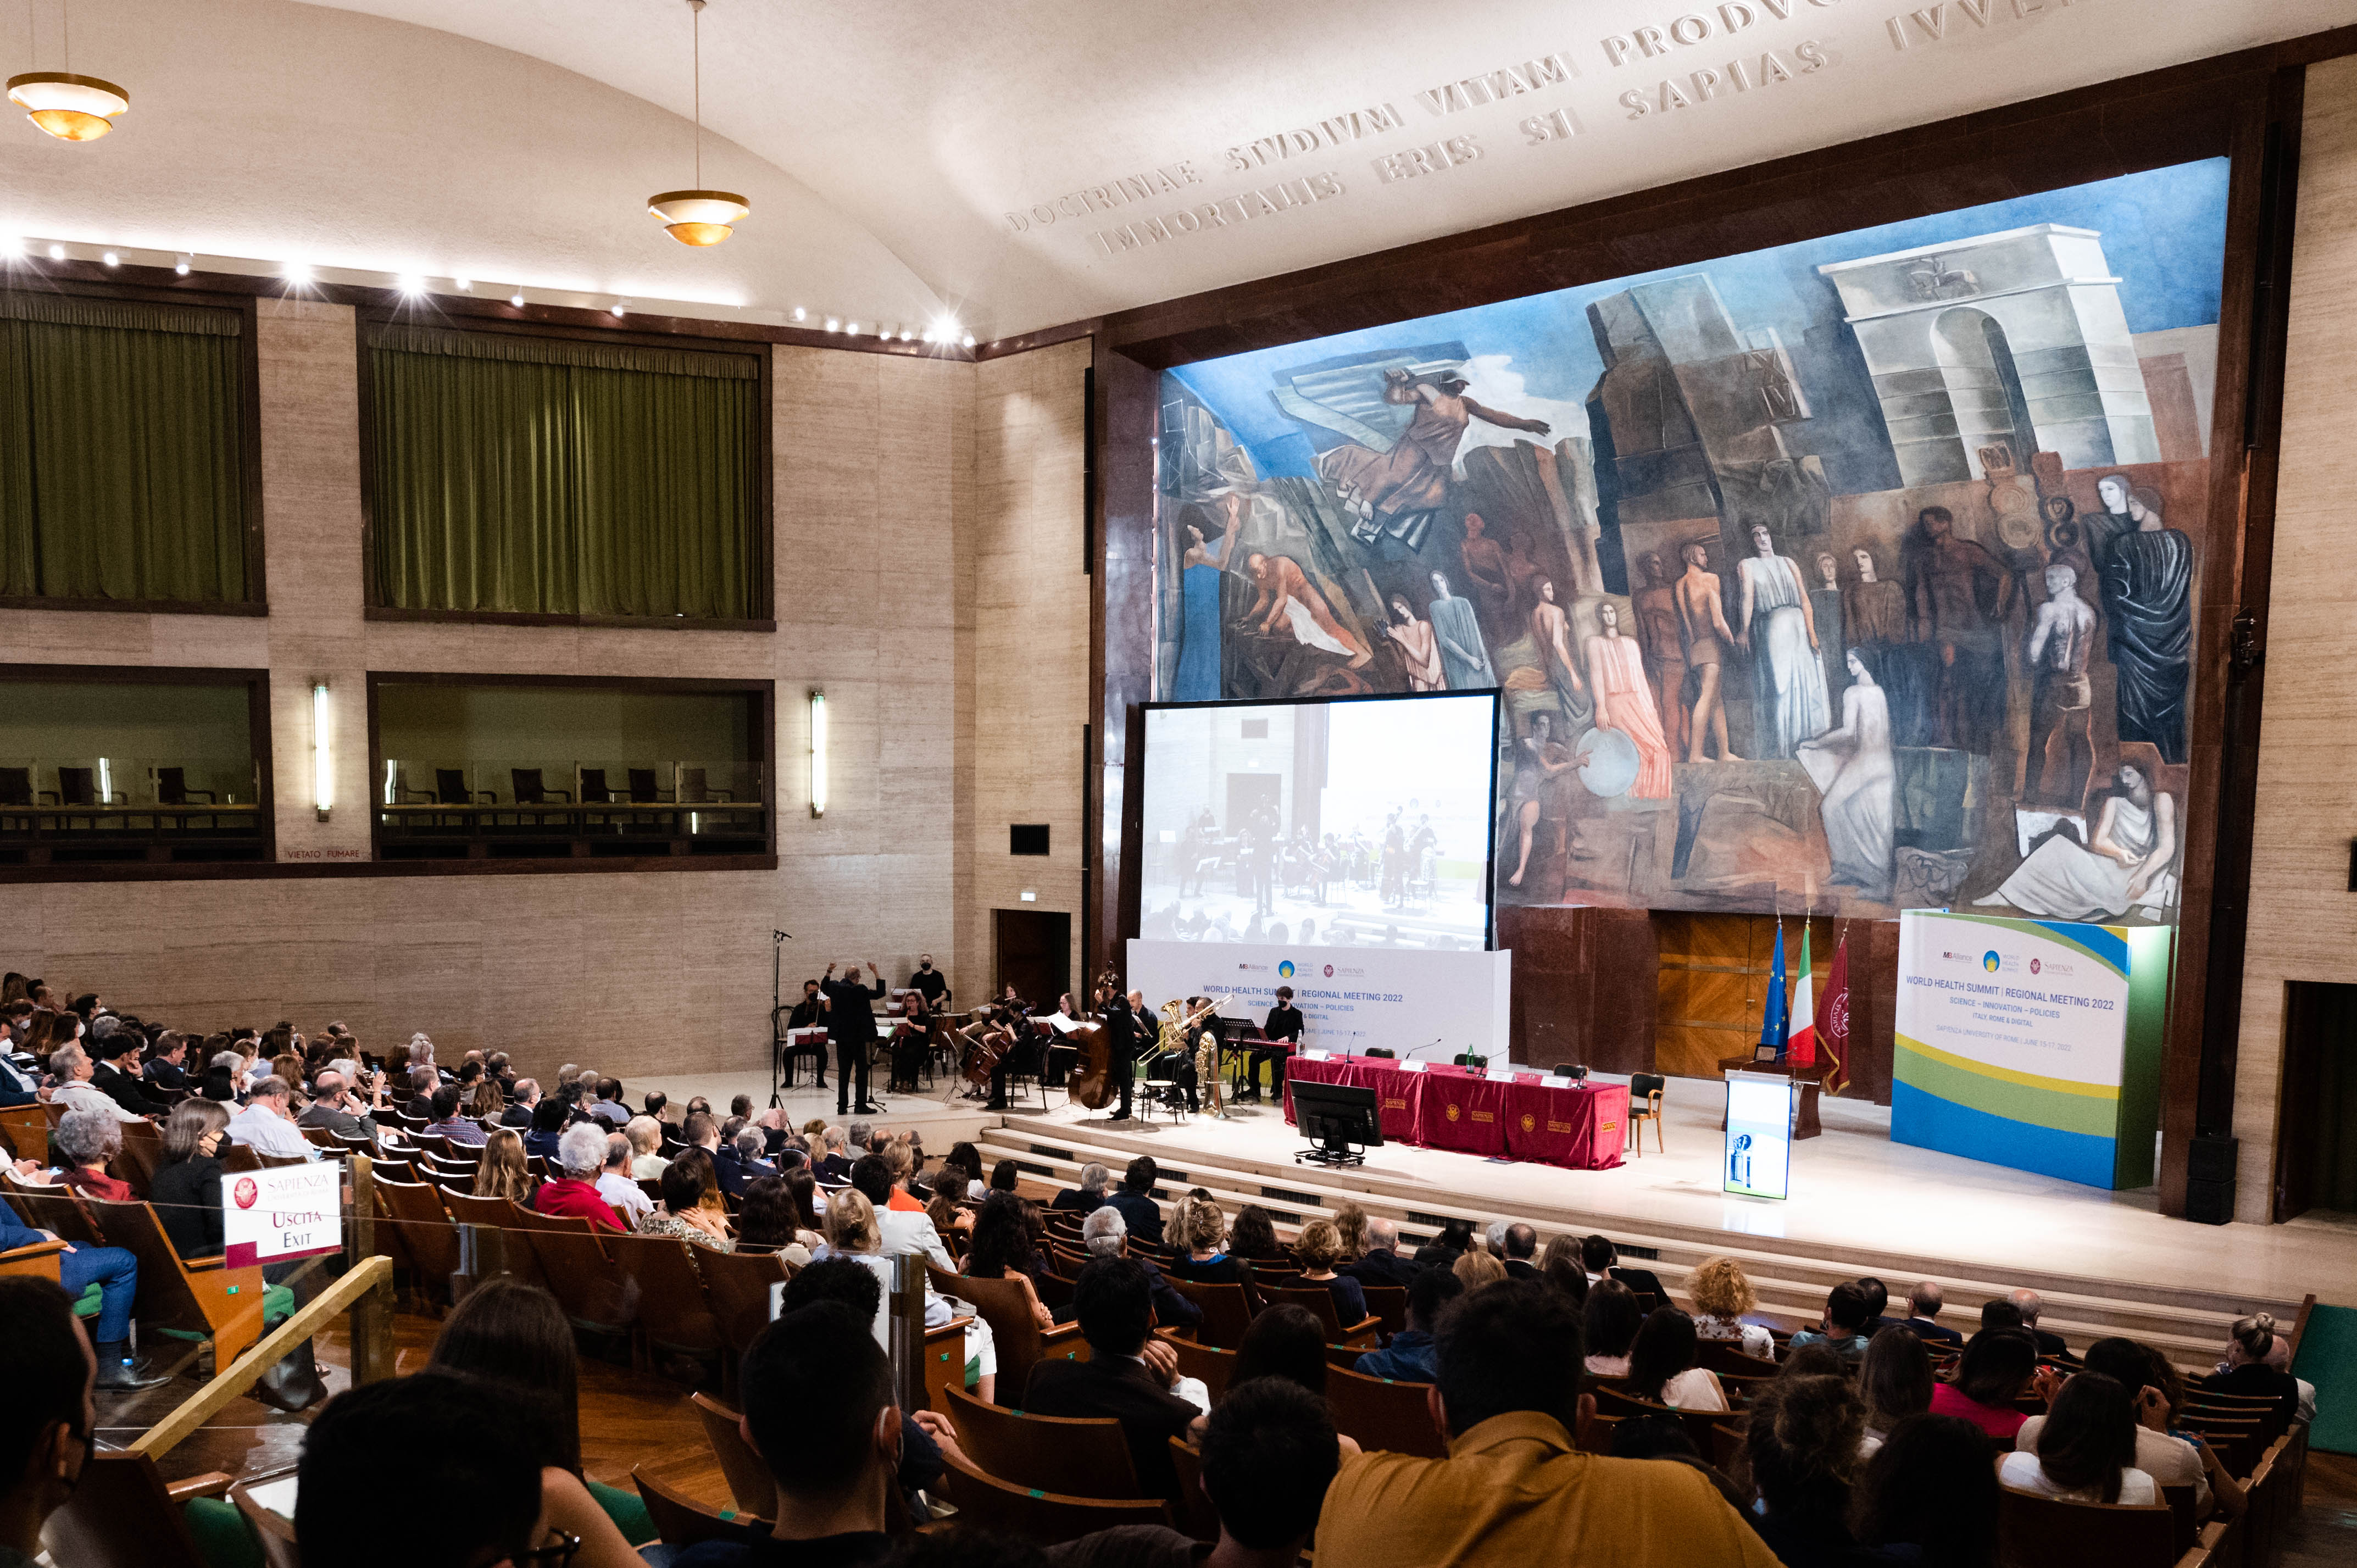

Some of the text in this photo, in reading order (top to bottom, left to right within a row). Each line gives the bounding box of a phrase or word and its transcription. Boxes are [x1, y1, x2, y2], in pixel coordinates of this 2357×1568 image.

[1003, 0, 1840, 232] DOCTRINAE STVDIVM VITAM PRODV
[1092, 171, 1344, 254] IMMORTALIS
[1374, 136, 1483, 183] ERIS
[1521, 107, 1577, 146] SI
[1619, 40, 1827, 120] SAPIAS
[2044, 963, 2074, 972] SAPIENZA
[1203, 985, 1230, 993] WORLD
[1302, 990, 1341, 999] REGIONAL
[1344, 992, 1381, 1001] MEETING
[1906, 976, 1933, 987] WORLD
[1934, 979, 1964, 991] HEALTH
[1966, 983, 2000, 995] SUMMIT
[2005, 988, 2048, 1002] REGIONAL
[2050, 994, 2089, 1007] MEETING
[2092, 999, 2114, 1010] 2022
[1950, 997, 1976, 1007] SCIENCE
[1983, 1001, 2022, 1013] INNOVATION
[2030, 1008, 2060, 1019] POLICIES
[2011, 1019, 2033, 1027] DIGITAL
[1936, 1025, 1961, 1034] SAPIENZA
[1963, 1029, 1994, 1039] UNIVERSITY
[2004, 1035, 2019, 1043] ROME
[2057, 1043, 2071, 1052] 2022
[268, 1174, 329, 1193] SAPIENZA
[273, 1211, 322, 1228] USCITA
[284, 1232, 312, 1248] EXIT
